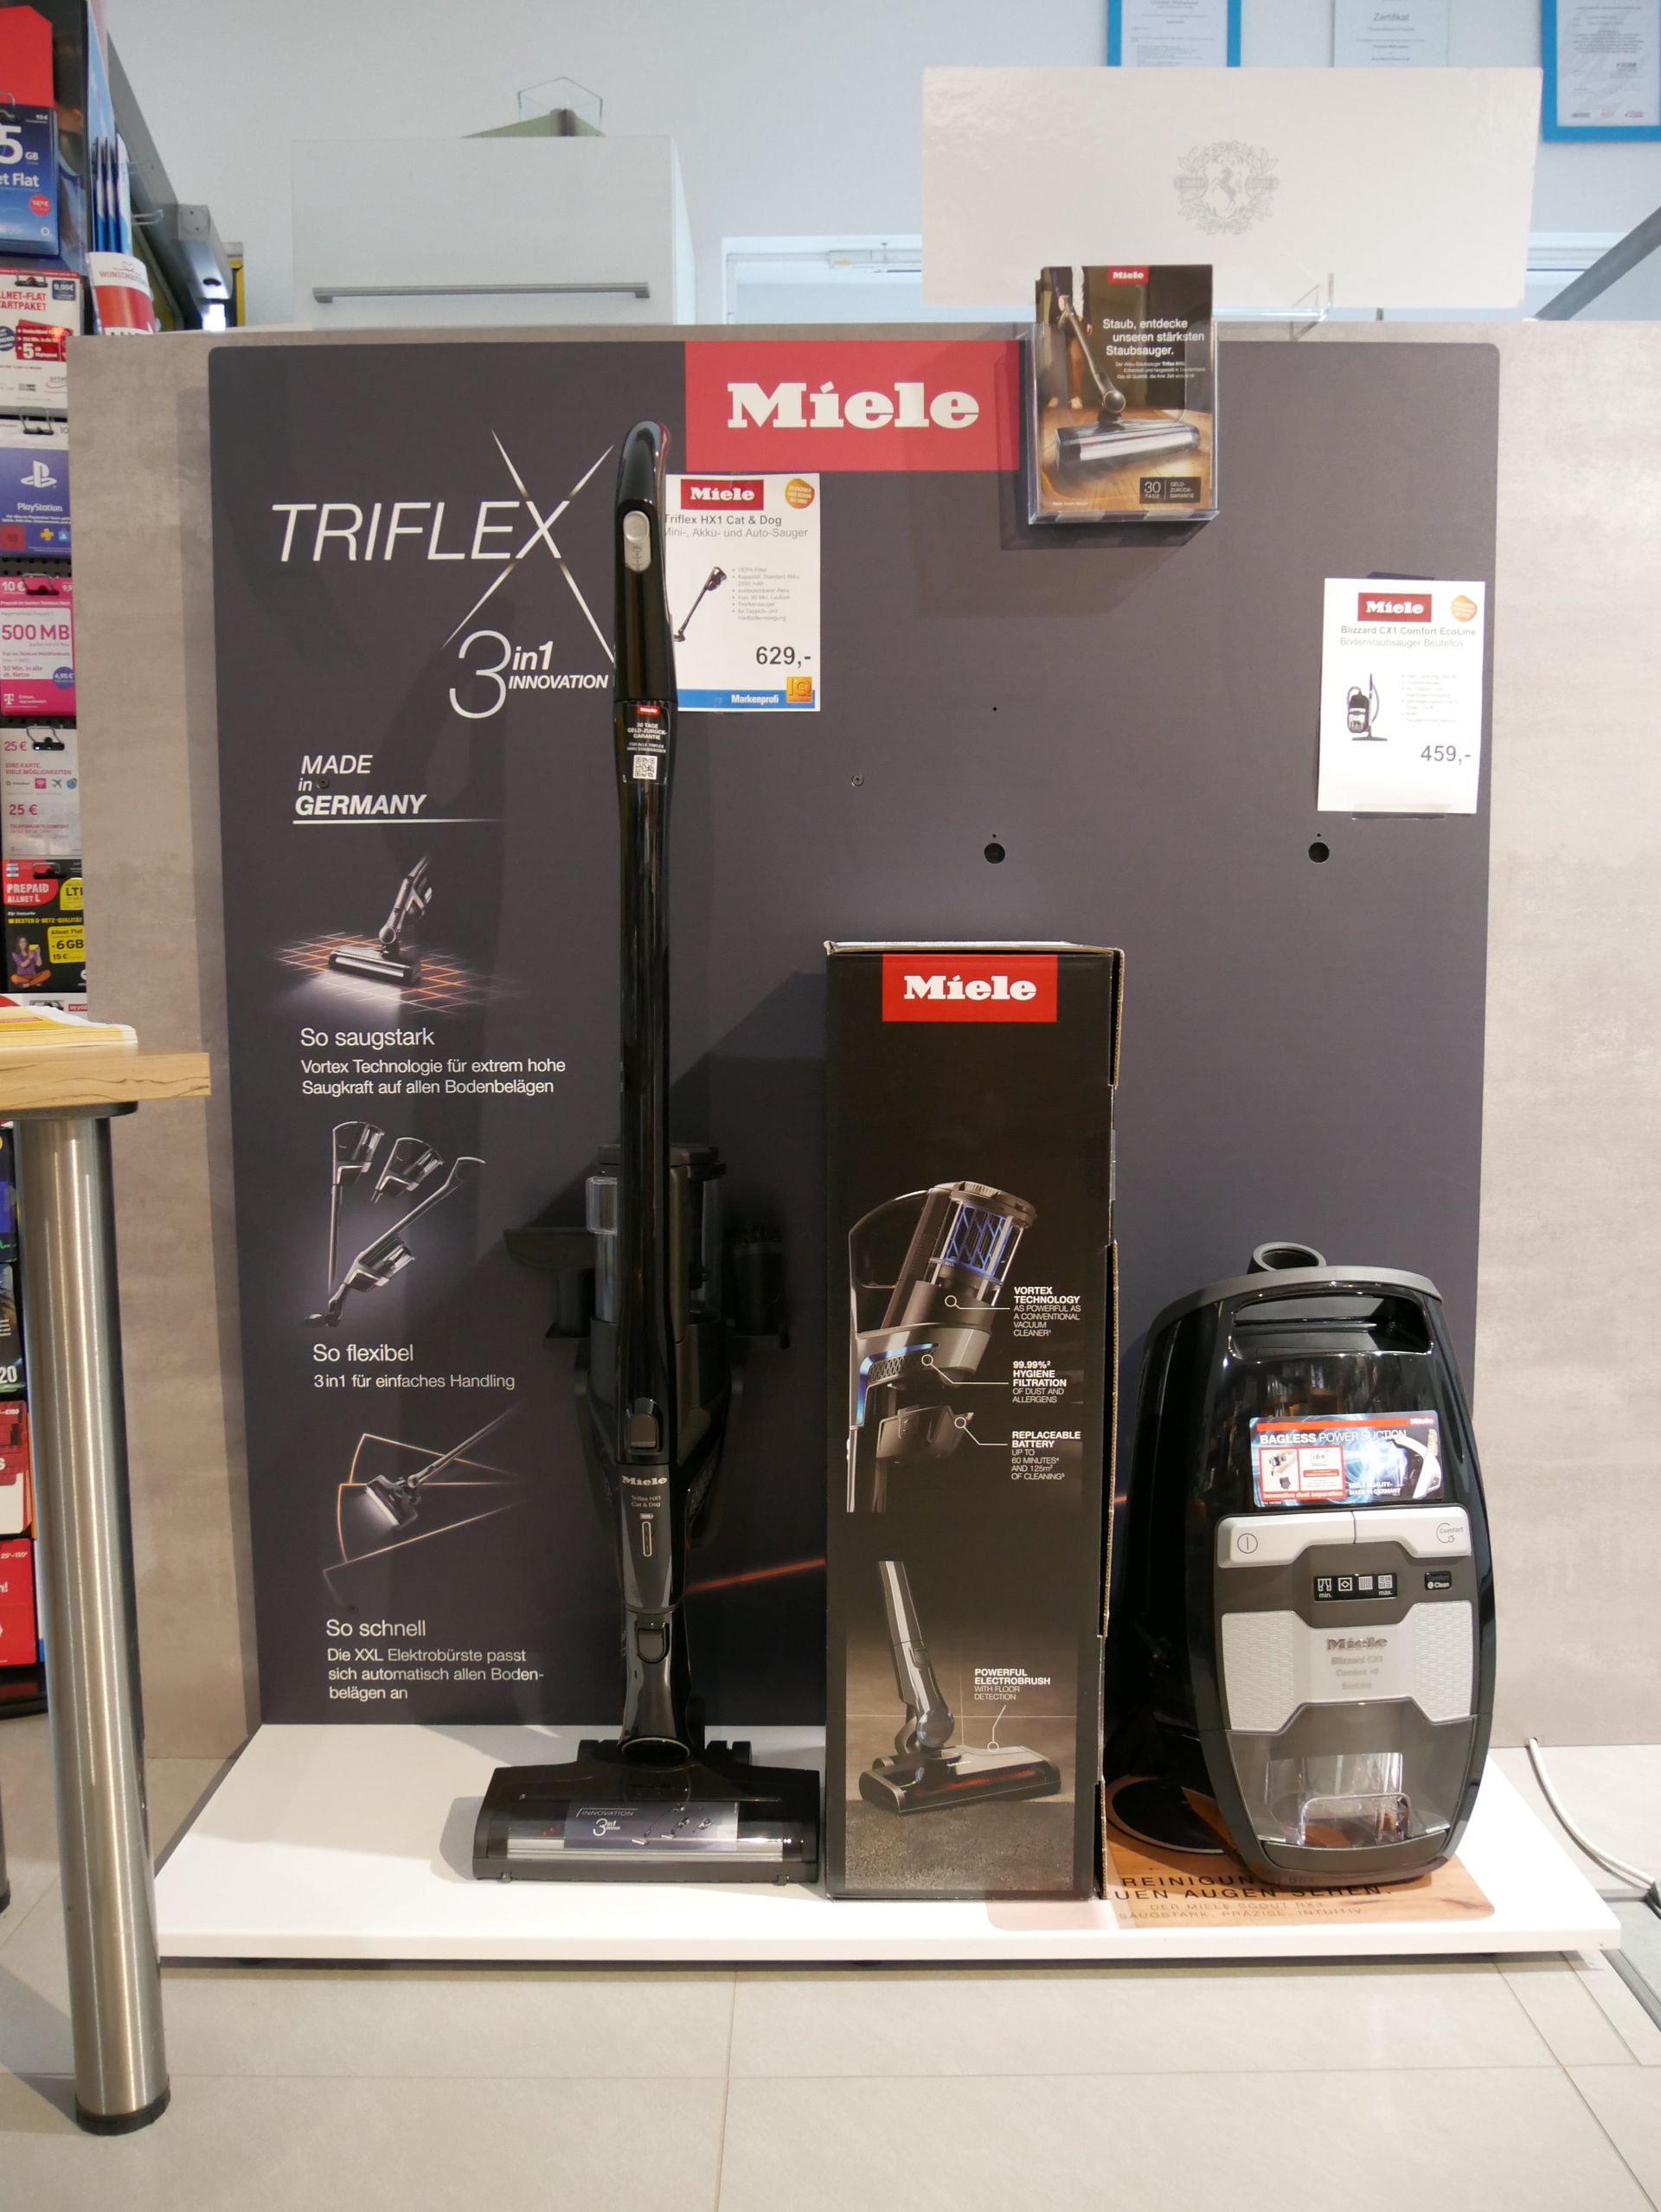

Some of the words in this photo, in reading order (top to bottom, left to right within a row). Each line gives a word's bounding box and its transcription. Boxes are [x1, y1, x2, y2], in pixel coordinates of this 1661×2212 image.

[1374, 12, 1409, 22] Zertifikat
[25, 152, 38, 161] GB
[12, 173, 40, 187] Flat
[1102, 318, 1137, 330] Staub,
[1140, 318, 1188, 329] entdecke
[1113, 334, 1154, 343] unseren
[1157, 332, 1204, 341] stärksten
[22, 343, 35, 358] 5
[1106, 345, 1174, 357] Staubsauger.
[728, 381, 979, 429] Miele
[1144, 481, 1161, 493] 30
[690, 488, 754, 501] Miele
[17, 502, 63, 513] PlayStation
[664, 515, 697, 525] Triflex
[701, 516, 722, 524] HX1
[727, 516, 744, 524] Cat
[748, 516, 756, 524] &
[760, 516, 782, 526] Dog
[272, 500, 571, 562] TRIFLEX
[692, 528, 721, 537] Akku-
[724, 528, 742, 537] und
[746, 528, 808, 539] Auto-Sauger
[2, 581, 16, 592] 10
[1366, 600, 1424, 614] Miele
[2, 625, 36, 640] 500
[41, 625, 69, 640] MB
[1341, 626, 1377, 635] Blizzard
[1379, 626, 1397, 635] CX1
[1400, 626, 1437, 636] Comfort
[1440, 627, 1476, 637] EcoLine
[1341, 638, 1421, 649] Bodenstaubsauger
[756, 646, 811, 668] 629,-
[509, 675, 608, 690] INNOVATION
[731, 694, 779, 708] Markenprofi
[4, 741, 17, 751] 25
[1421, 745, 1471, 765] 459,-
[301, 754, 373, 774] MADE
[298, 779, 311, 792] in
[9, 805, 25, 815] 25
[295, 794, 427, 815] GERMANY
[7, 883, 49, 894] PREPAID
[904, 975, 1036, 1001] Miele
[300, 1028, 329, 1047] So
[335, 1028, 435, 1050] saugstark
[301, 1060, 350, 1074] Vortex
[353, 1059, 443, 1076] Technologie
[446, 1059, 467, 1073] für
[471, 1061, 523, 1073] extrem
[528, 1059, 566, 1073] hohe
[302, 1080, 374, 1097] Saugkraft
[378, 1080, 401, 1093] auf
[406, 1080, 440, 1093] allen
[445, 1080, 554, 1096] Bodenbelägen
[1014, 1296, 1080, 1305] TECHNOLOGY
[313, 1343, 341, 1362] So
[346, 1343, 414, 1362] flexibel
[351, 1374, 372, 1388] für
[375, 1374, 446, 1388] einfaches
[450, 1374, 516, 1391] Handling
[1013, 1379, 1068, 1388] FILTRATION
[1012, 1431, 1081, 1439] REPLACEABLE
[1260, 1433, 1317, 1445] BAGLESS
[1318, 1433, 1358, 1443] POWER
[1362, 1429, 1407, 1441] SUCTION
[1012, 1439, 1055, 1448] BATTERY
[623, 1475, 668, 1486] Miele
[326, 1619, 353, 1637] So
[359, 1619, 426, 1637] schnell
[1327, 1638, 1388, 1651] Miele
[327, 1648, 351, 1662] Die
[355, 1649, 384, 1662] XXL
[388, 1649, 483, 1663] Elektrobürste
[487, 1649, 526, 1664] passt
[329, 1668, 356, 1680] sich
[362, 1668, 449, 1681] automatisch
[453, 1668, 486, 1680] allen
[491, 1668, 544, 1681] Boden-
[329, 1687, 386, 1702] belägen
[389, 1689, 408, 1699] an
[1122, 1875, 1256, 1888] REINIGUN
[1185, 1888, 1277, 1898] AUGEN
